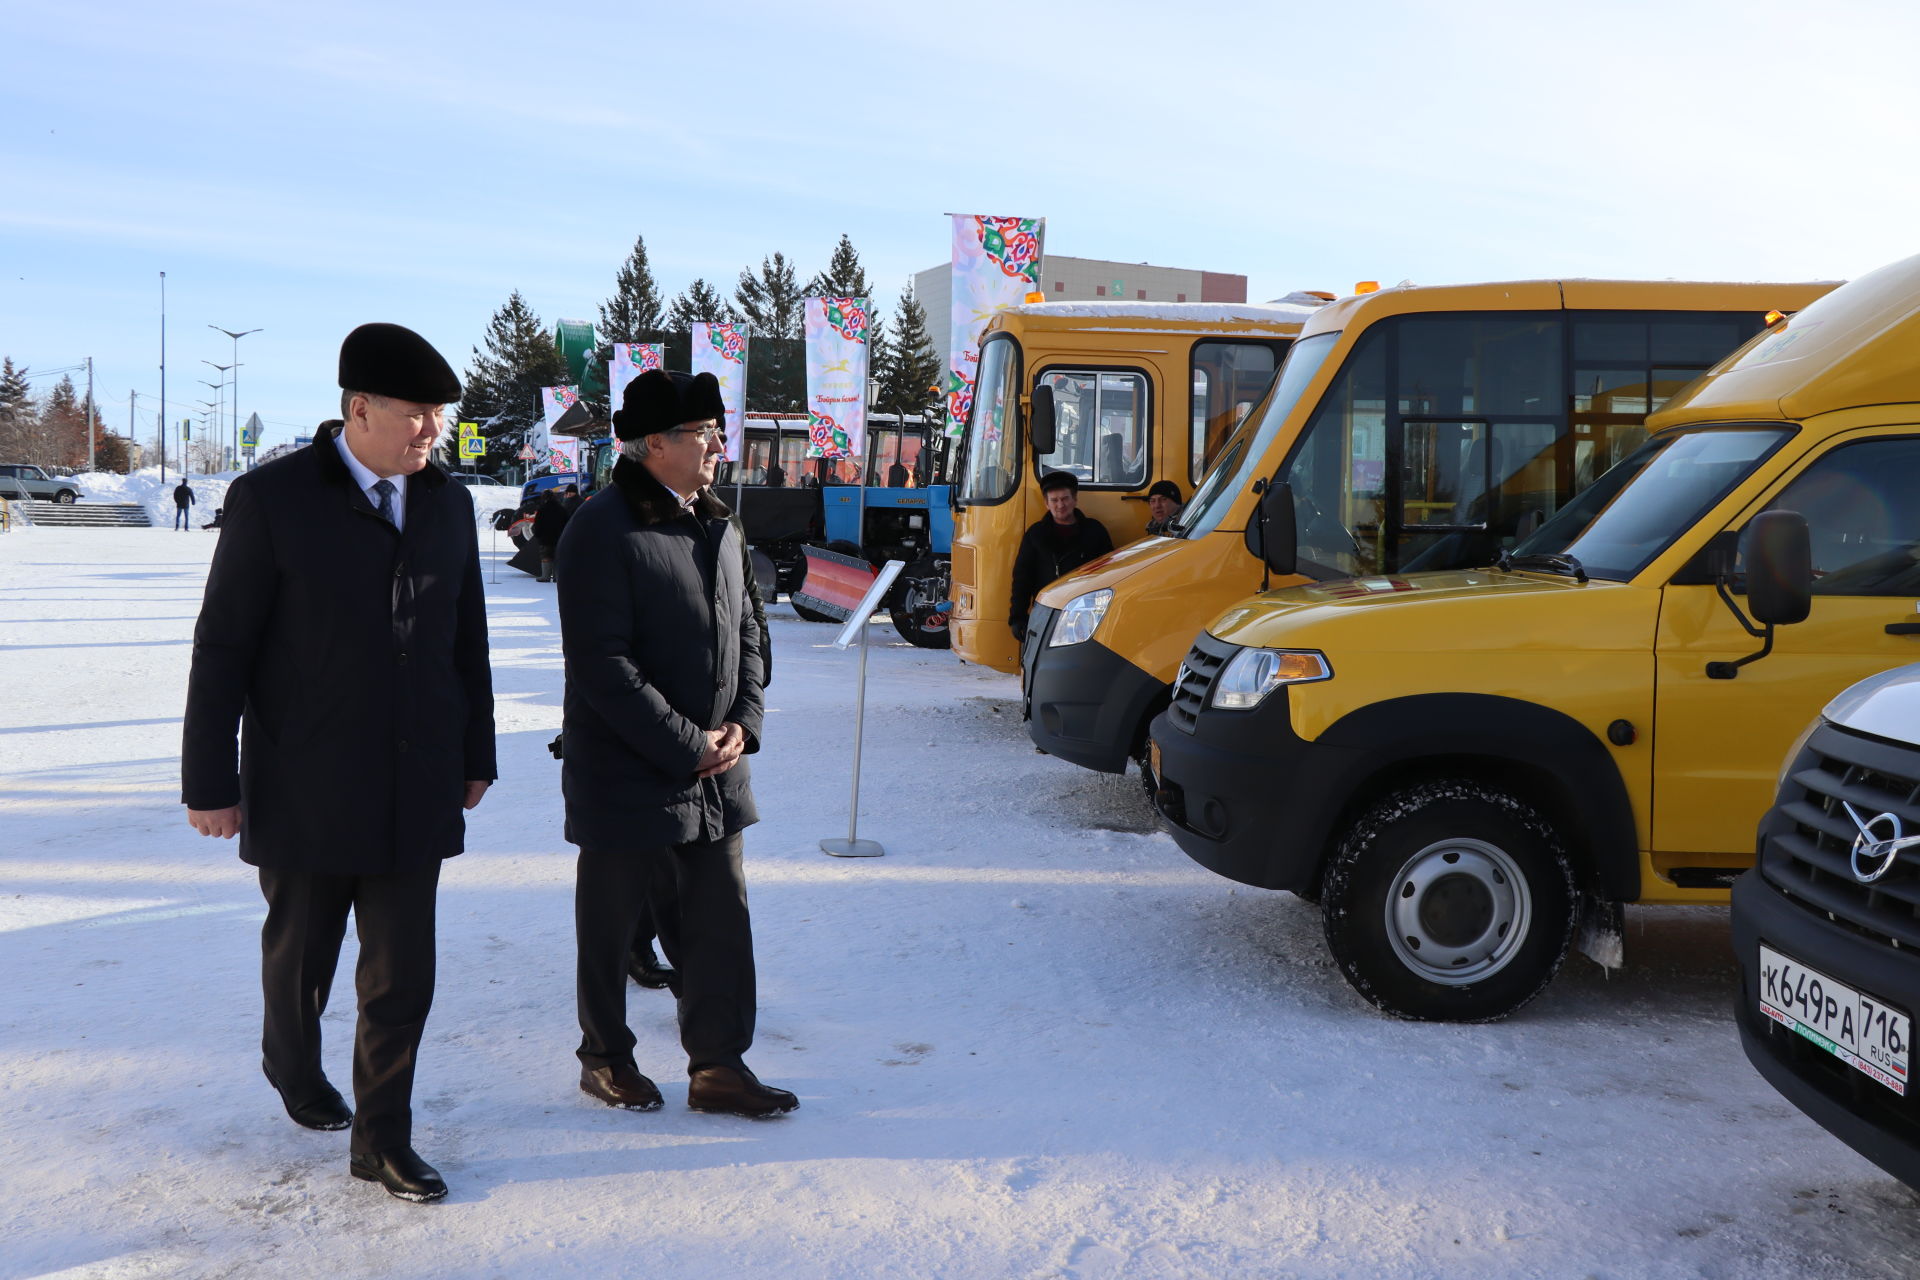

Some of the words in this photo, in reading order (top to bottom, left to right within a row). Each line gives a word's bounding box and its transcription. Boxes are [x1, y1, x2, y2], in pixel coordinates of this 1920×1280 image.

[1767, 965, 1855, 1045] К649РА
[1861, 1001, 1901, 1054] 716
[1870, 1045, 1891, 1067] RUS
